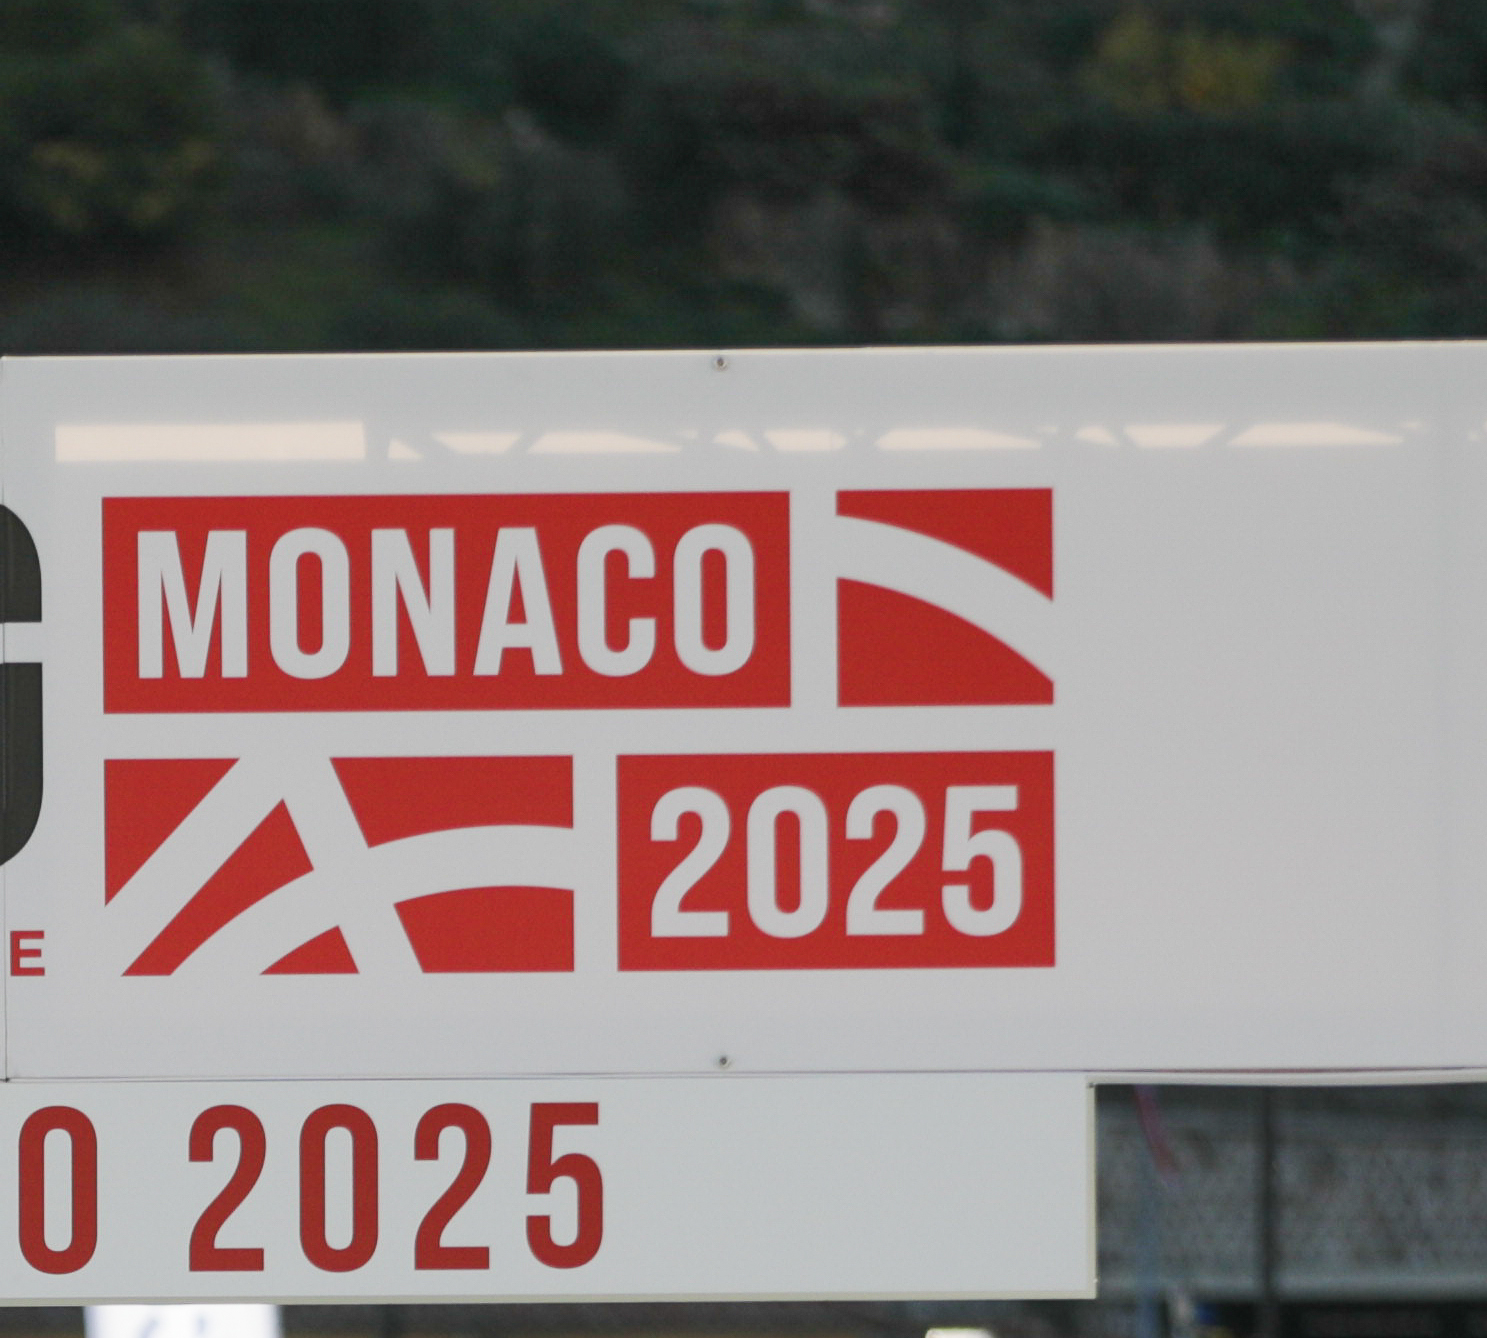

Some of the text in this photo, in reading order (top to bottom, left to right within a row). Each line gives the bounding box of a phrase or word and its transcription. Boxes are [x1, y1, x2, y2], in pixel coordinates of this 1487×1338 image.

[136, 522, 757, 680] MONACO
[650, 783, 1024, 940] 2025
[188, 1101, 604, 1273] 2025
